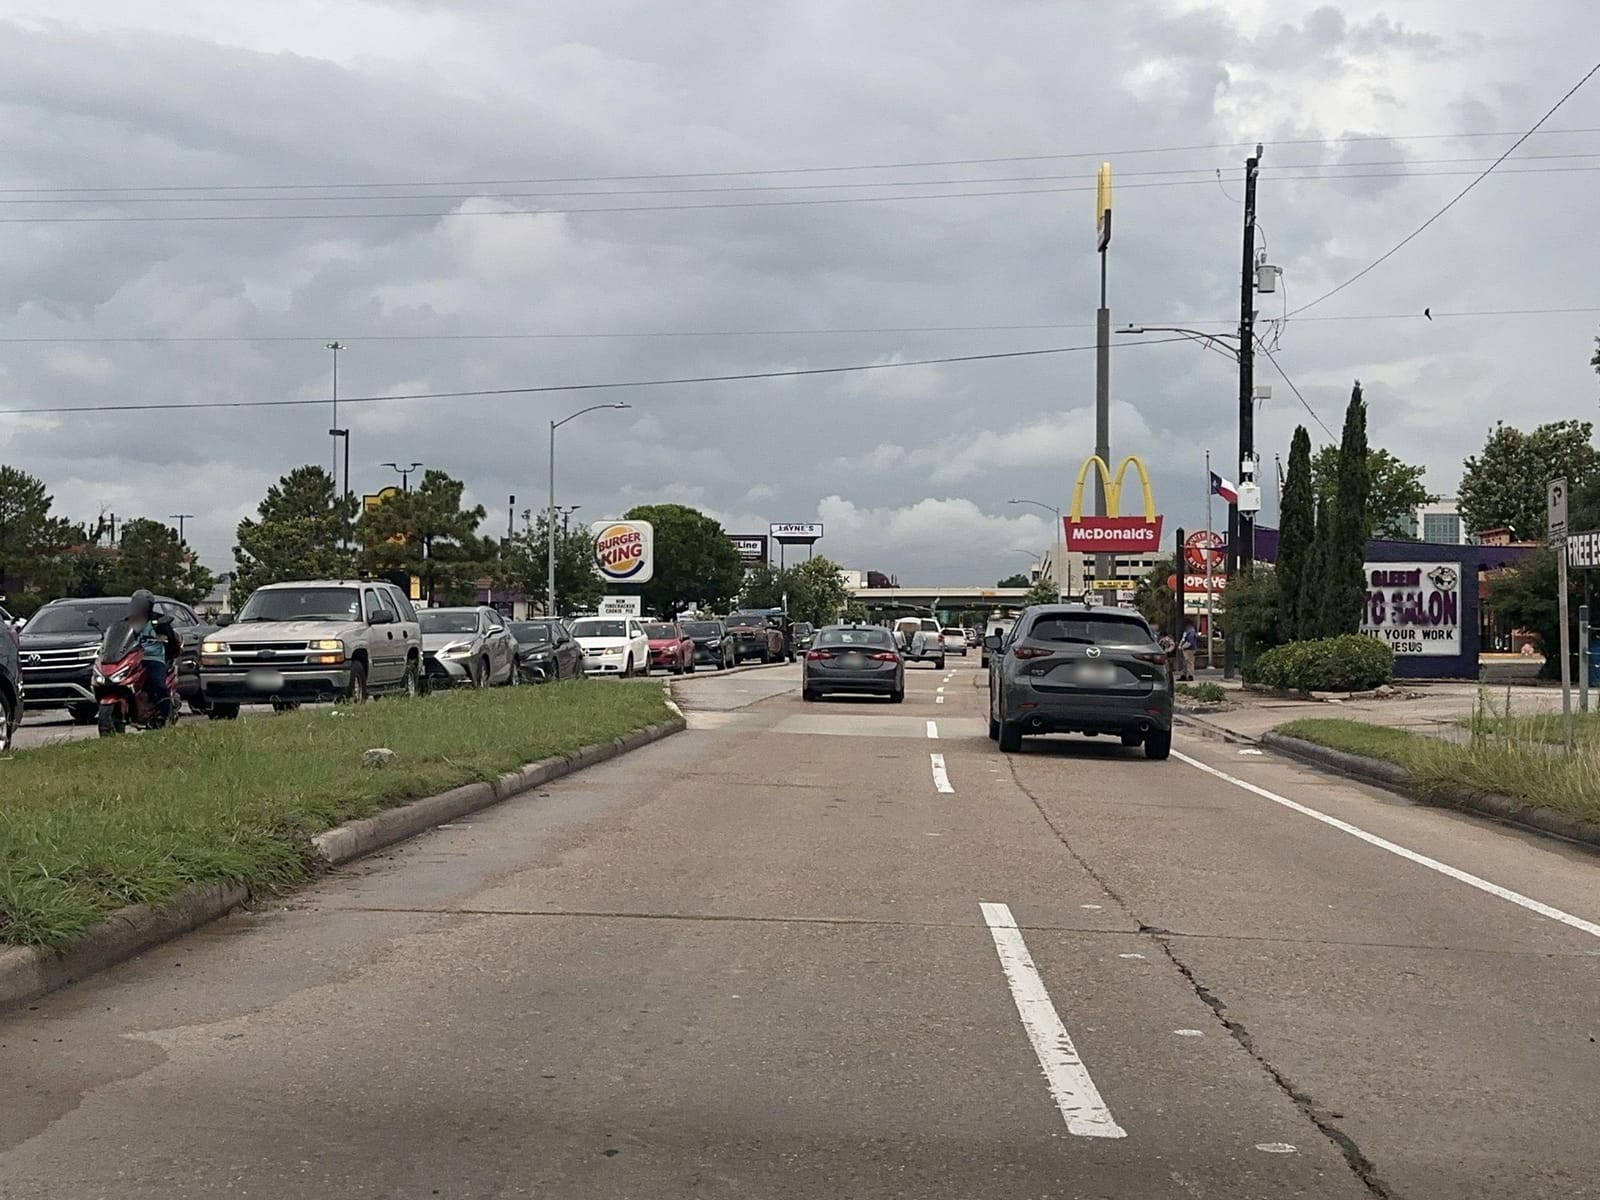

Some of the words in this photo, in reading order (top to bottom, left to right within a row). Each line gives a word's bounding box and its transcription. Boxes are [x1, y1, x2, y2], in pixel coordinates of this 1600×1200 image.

[598, 531, 641, 553] BURGER
[1072, 528, 1154, 540] McDonald's
[601, 543, 643, 567] KING
[1567, 535, 1590, 566] FREE
[1592, 534, 1600, 566] E
[1184, 576, 1227, 589] OPEYE
[1384, 629, 1416, 640] YOUR
[1422, 630, 1454, 640] WORK
